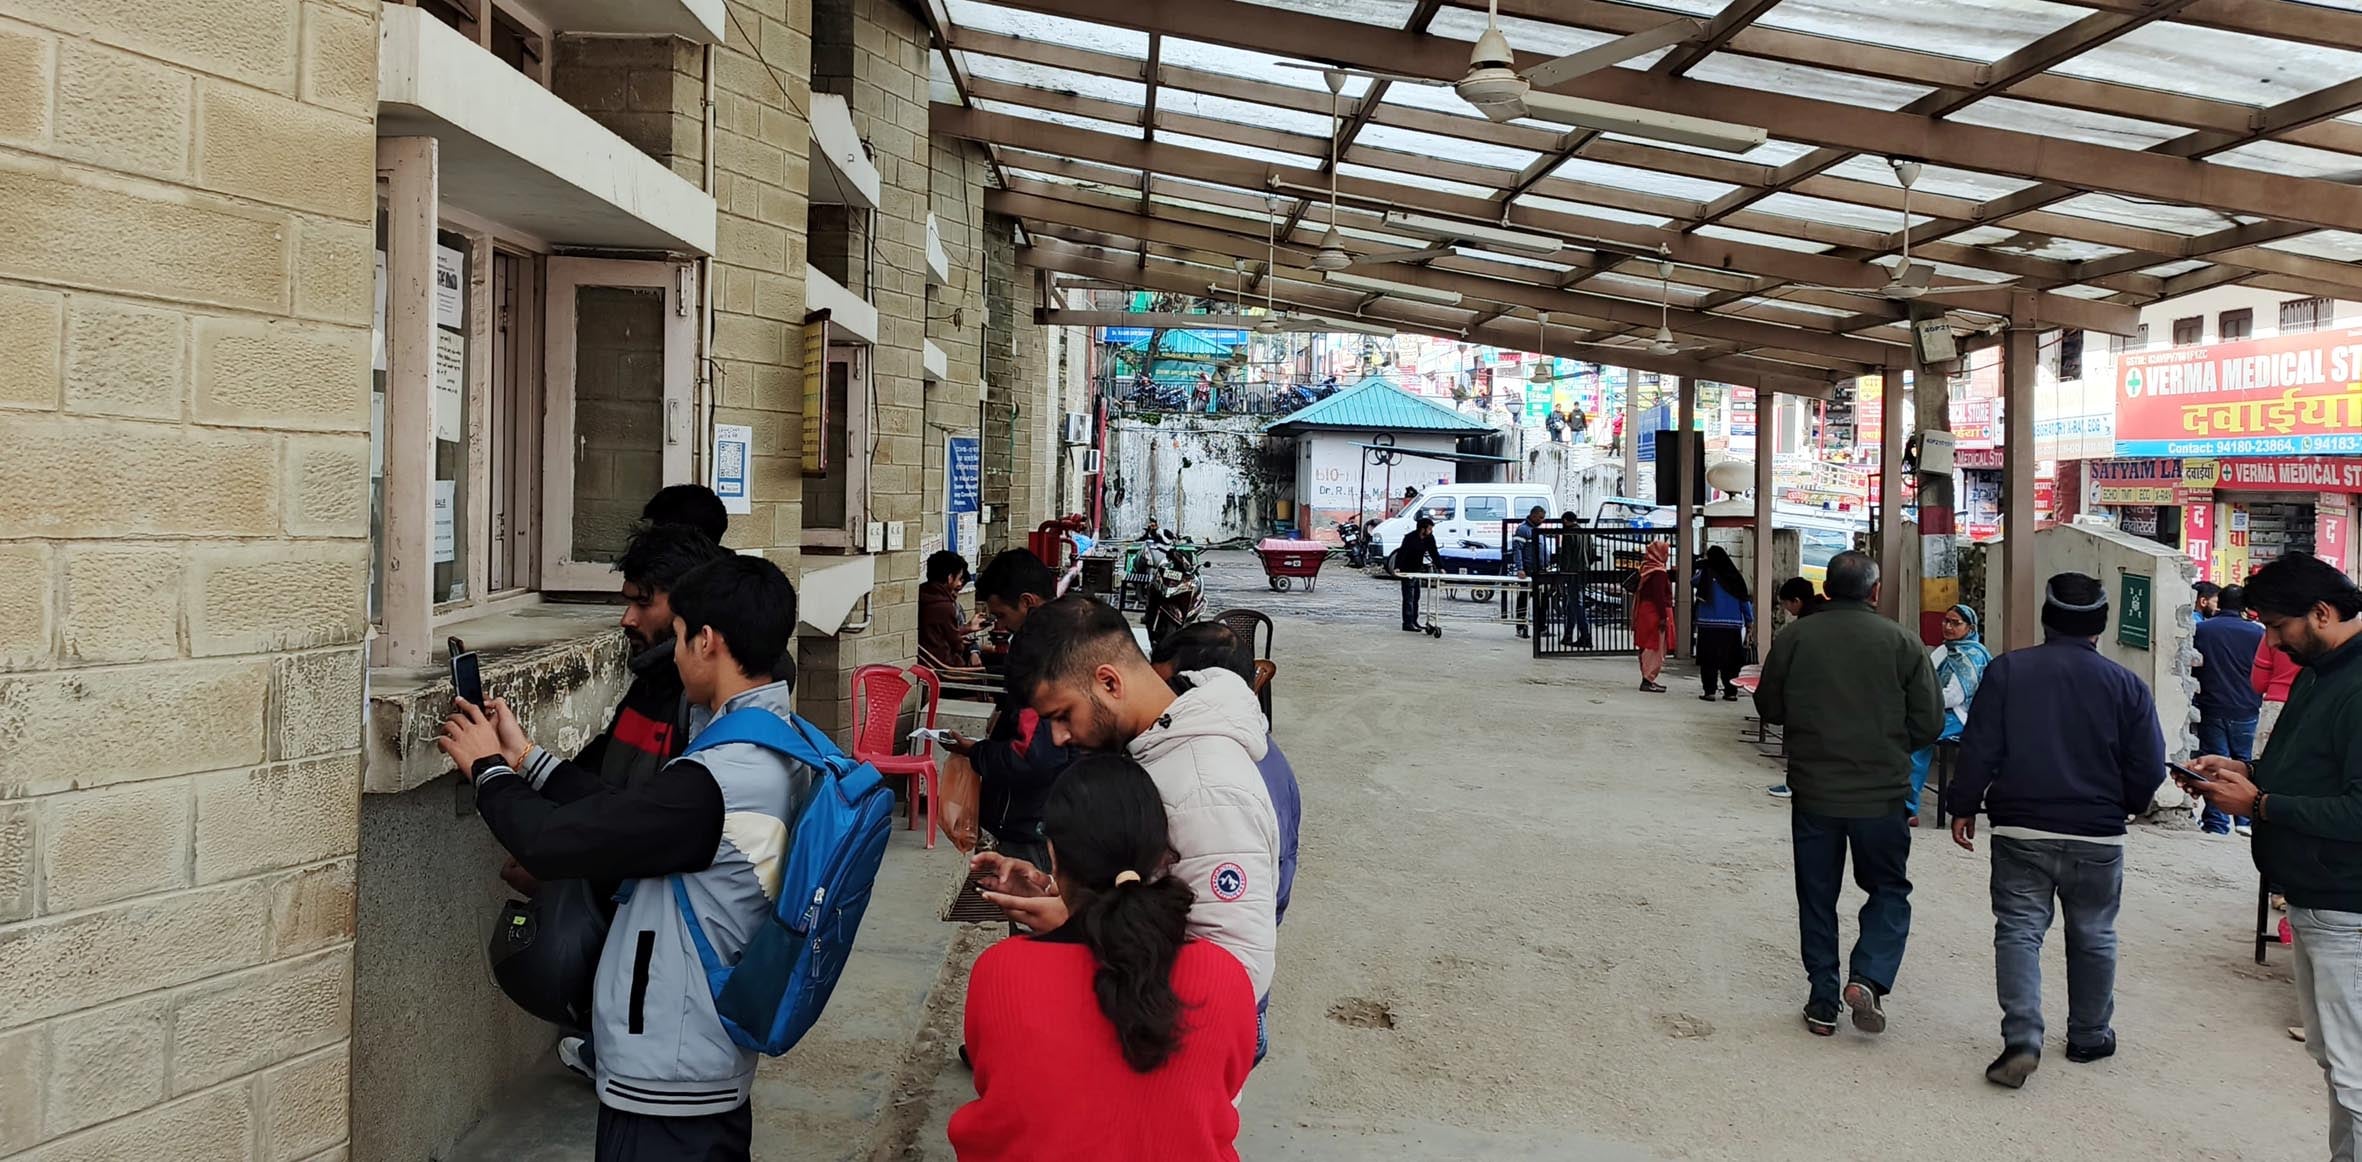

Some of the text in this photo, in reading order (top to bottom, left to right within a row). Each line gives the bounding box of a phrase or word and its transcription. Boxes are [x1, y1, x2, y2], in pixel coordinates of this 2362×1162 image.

[2146, 361, 2217, 396] VERMA
[2222, 349, 2325, 391] MEDICAL
[2168, 441, 2214, 454] Contact:
[2216, 438, 2295, 454] 94180-23864,
[2091, 461, 2155, 479] SATYAM
[2235, 463, 2276, 483] VERMA
[2279, 463, 2340, 486] MEDICAL
